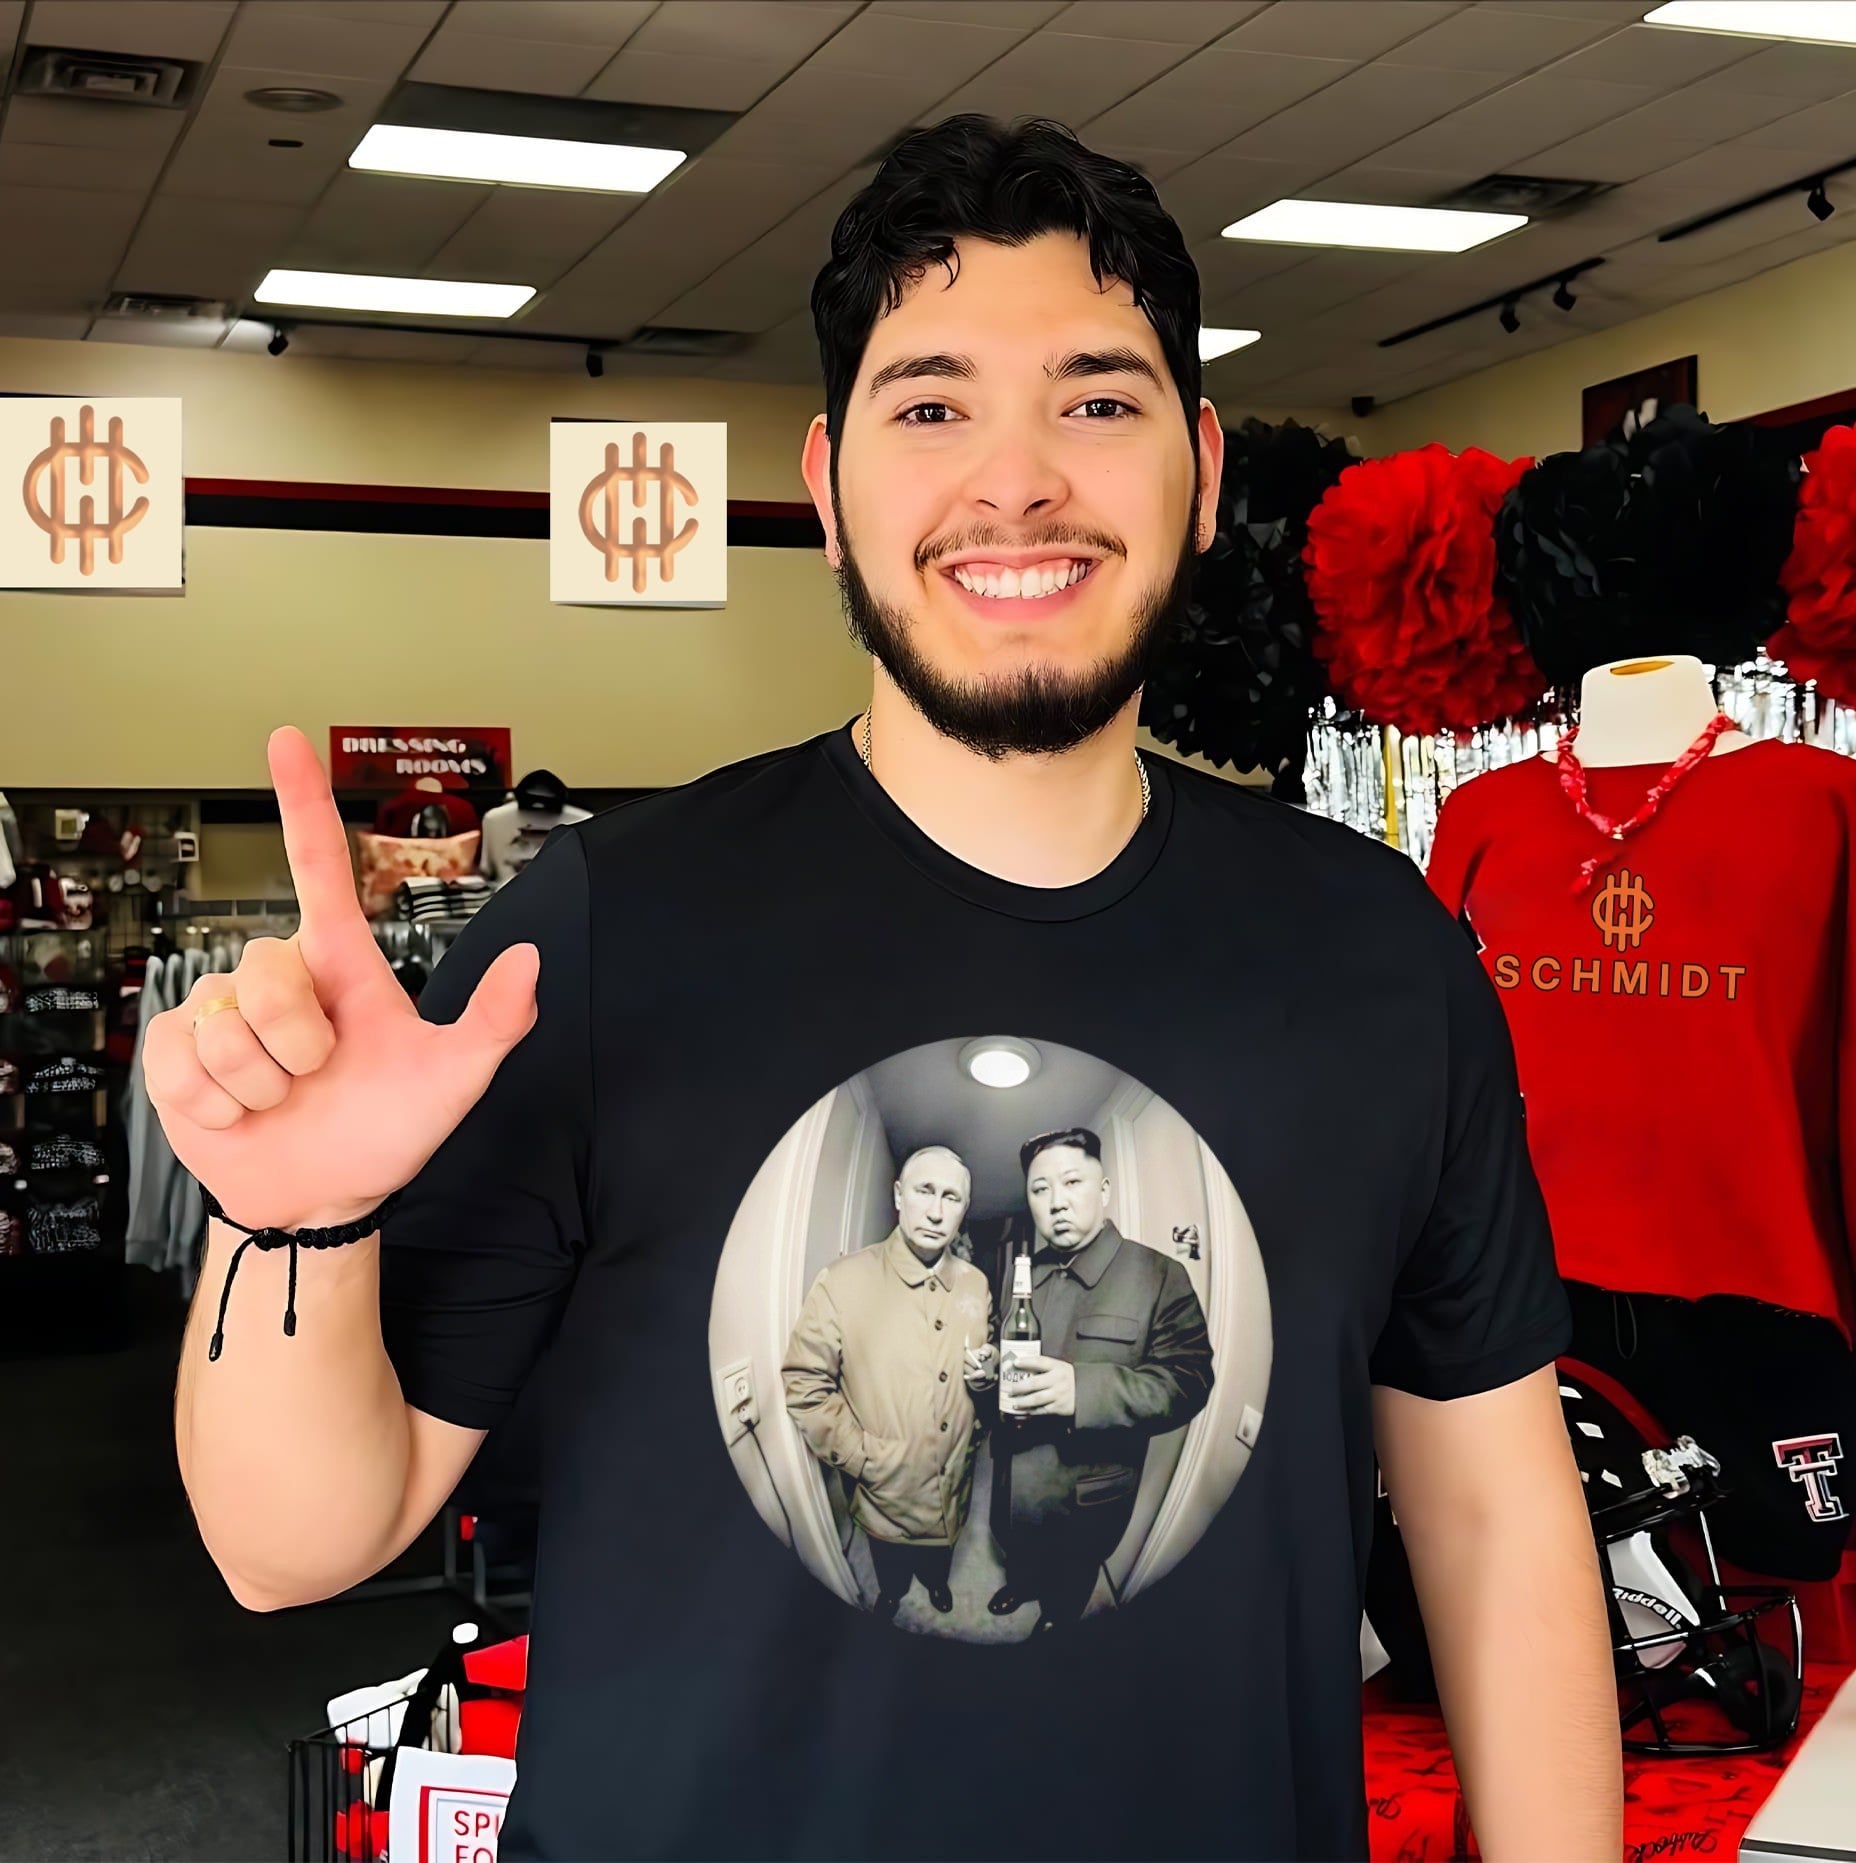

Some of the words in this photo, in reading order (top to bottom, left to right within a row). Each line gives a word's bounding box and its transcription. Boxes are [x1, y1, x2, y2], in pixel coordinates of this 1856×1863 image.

[342, 737, 467, 754] DRESSING
[396, 758, 487, 775] ROOMS
[1494, 953, 1747, 1000] SCHMIDT
